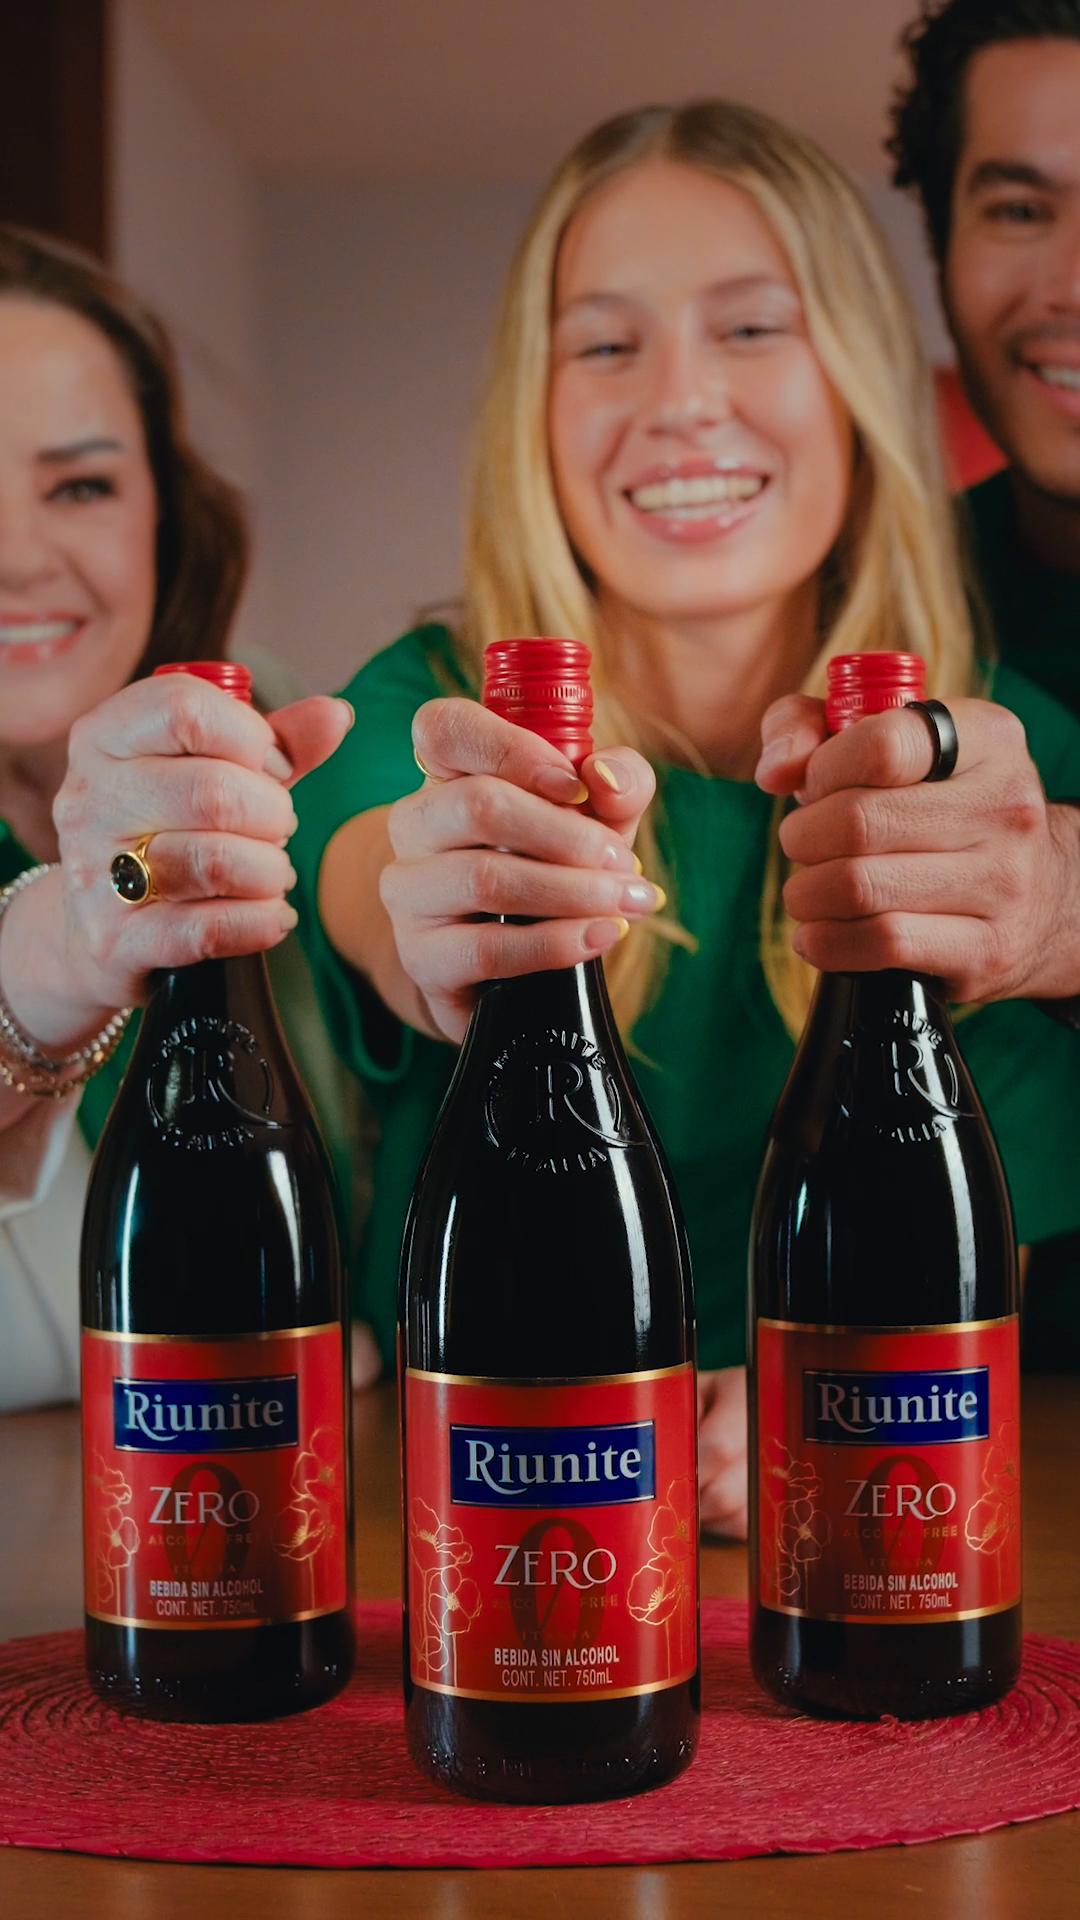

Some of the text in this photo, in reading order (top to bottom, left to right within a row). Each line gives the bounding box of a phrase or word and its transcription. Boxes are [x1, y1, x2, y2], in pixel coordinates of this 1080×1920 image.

[124, 1389, 284, 1441] Riunite
[817, 1383, 978, 1434] Riunite
[464, 1439, 641, 1495] Riunite
[148, 1486, 260, 1527] ZERO
[843, 1479, 957, 1521] ZERO
[923, 1525, 959, 1539] FREE
[493, 1545, 617, 1589] ZERO
[150, 1578, 264, 1598] BEBIDA SIN ALCOHOL
[843, 1571, 959, 1591] BEBIDA SIN ALCOHOL
[156, 1600, 190, 1617] CONT.
[193, 1600, 219, 1617] NET.
[579, 1594, 619, 1609] FREE
[851, 1592, 953, 1610] CONT. NET. 750mL
[494, 1645, 620, 1667] BEBIDA SIN ALCOHOL
[501, 1668, 613, 1687] CONT. NET. 750mL
